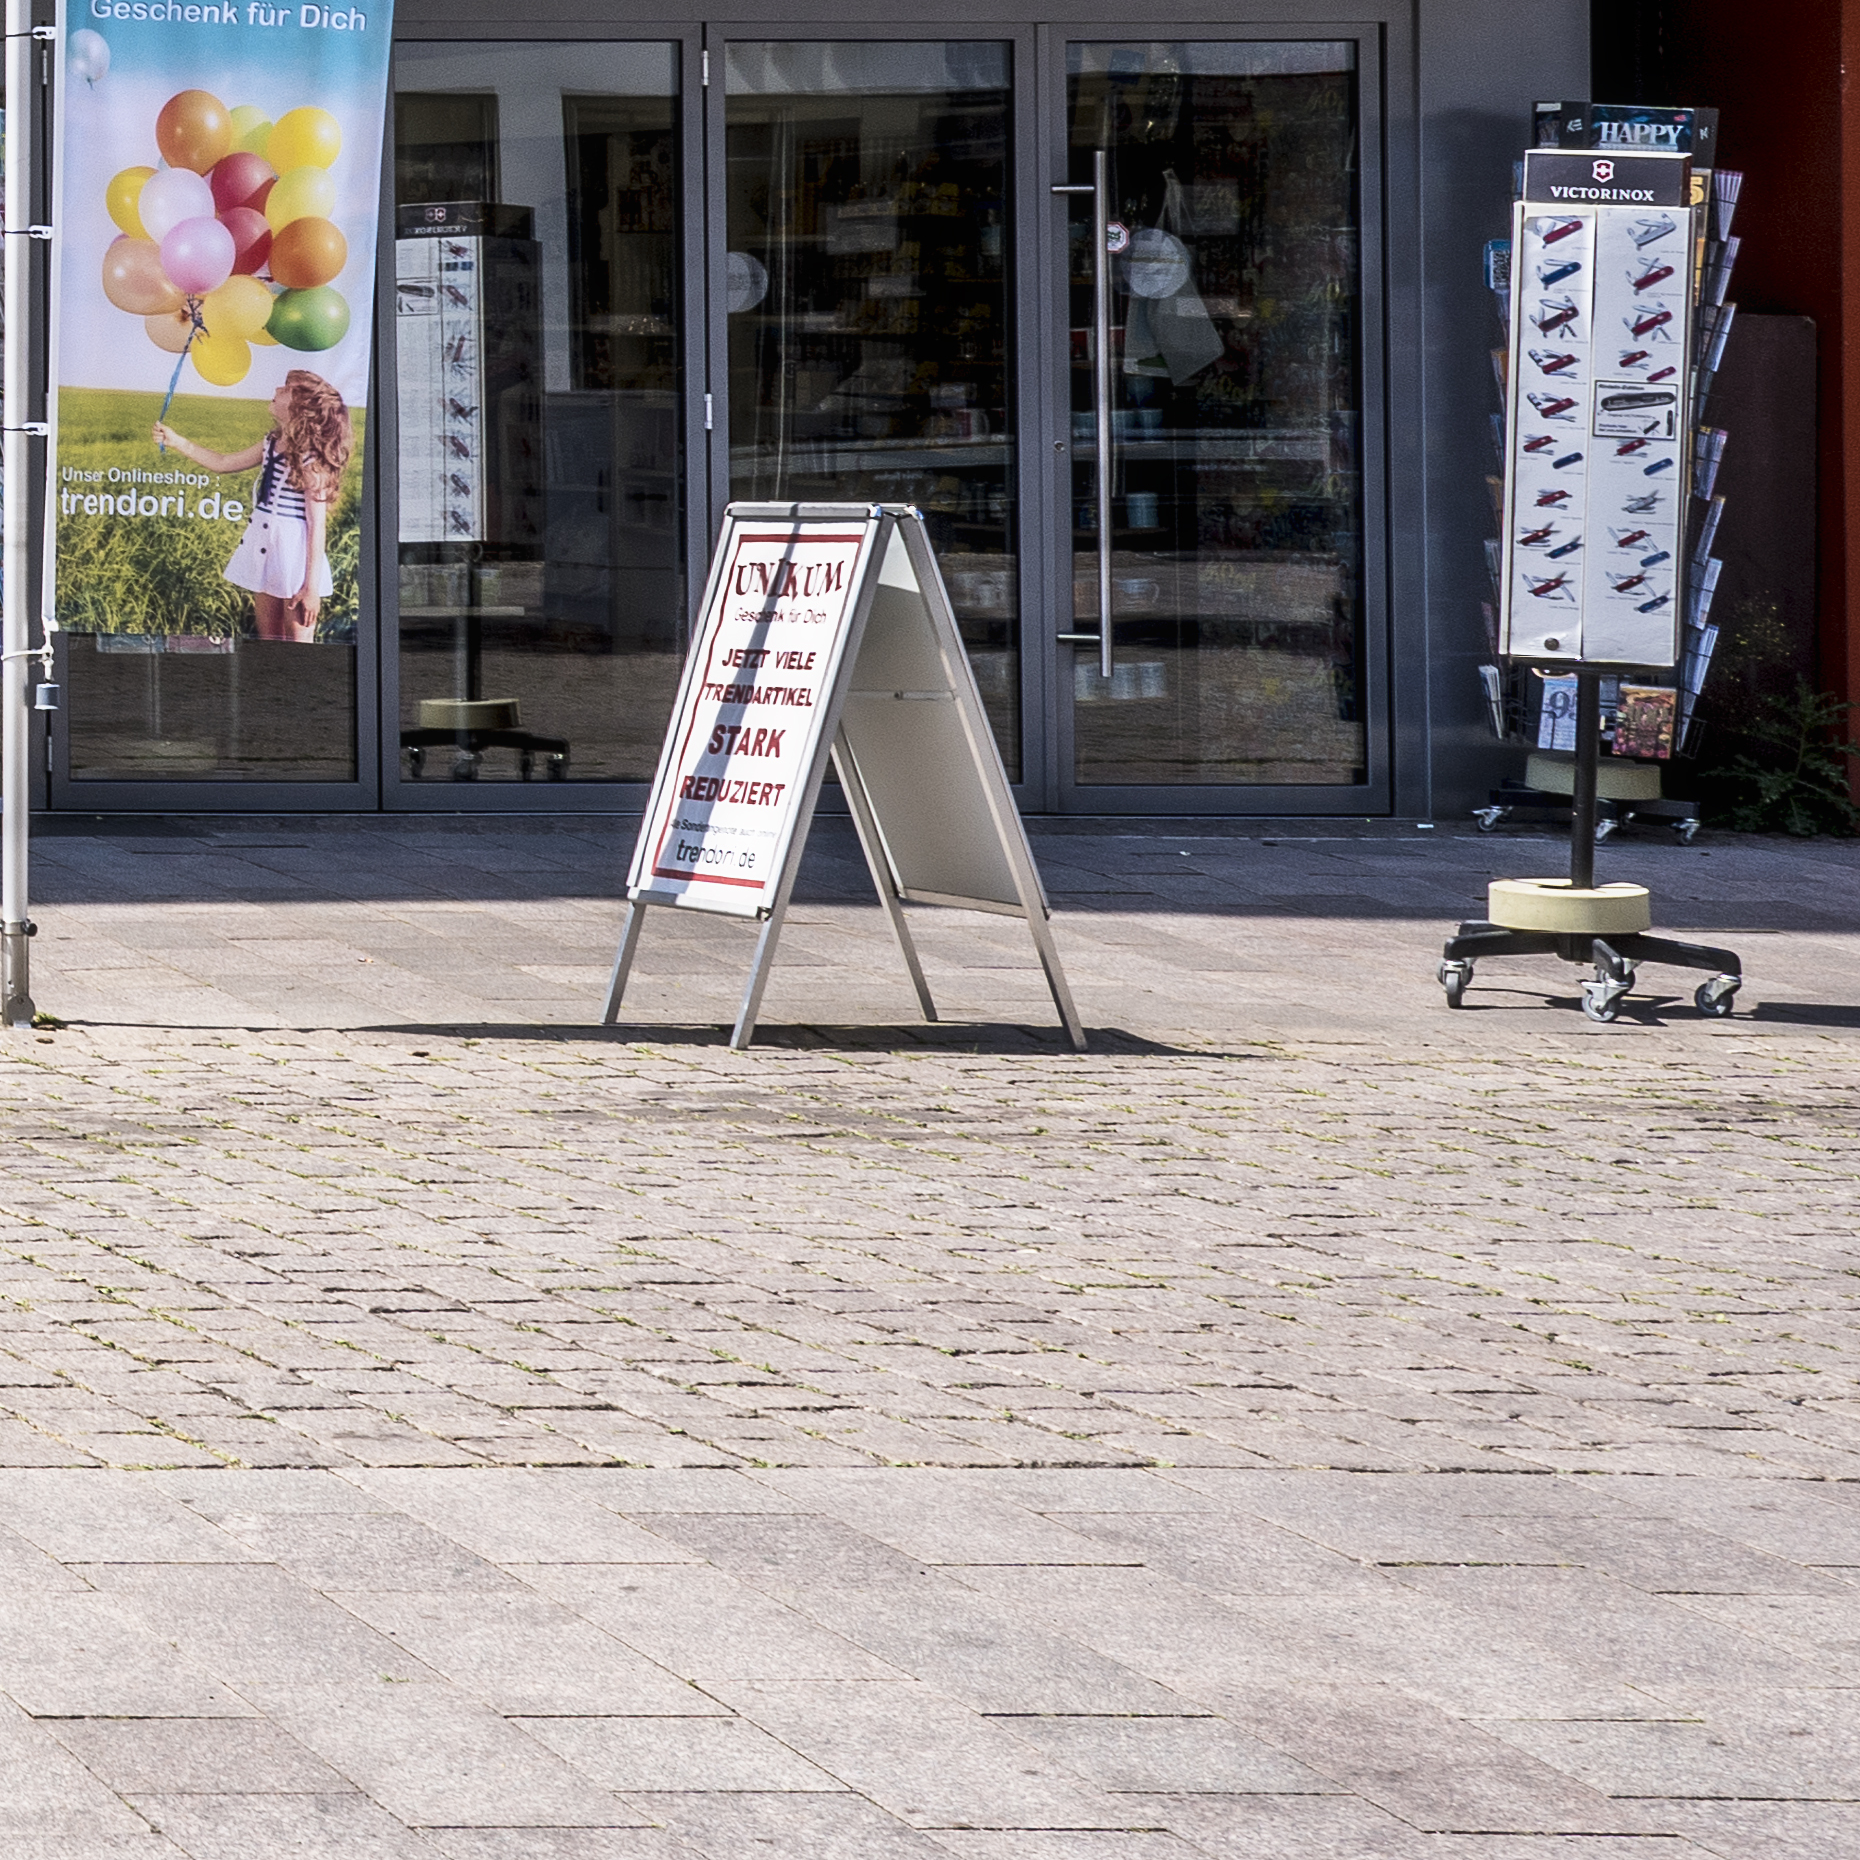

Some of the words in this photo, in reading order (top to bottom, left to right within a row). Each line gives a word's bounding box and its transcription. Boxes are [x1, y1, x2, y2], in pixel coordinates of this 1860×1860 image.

[247, 1, 291, 27] für
[299, 3, 368, 31] Dich
[1599, 121, 1684, 145] HAPPY
[1549, 185, 1655, 202] VICTORINOX
[62, 466, 104, 484] Unser
[108, 467, 210, 490] Onlineshop
[61, 486, 245, 523] trendori.de
[735, 558, 845, 601] UNIKUM
[734, 607, 785, 624] Geschenk
[788, 608, 802, 624] für
[803, 608, 827, 625] Dich
[722, 648, 771, 669] JETZT
[775, 650, 817, 670] VIELE
[703, 682, 814, 708] TRENDARTIKEL
[707, 724, 787, 759] STARK
[679, 775, 786, 807] REDUZIERT
[676, 839, 756, 869] trendori.de
